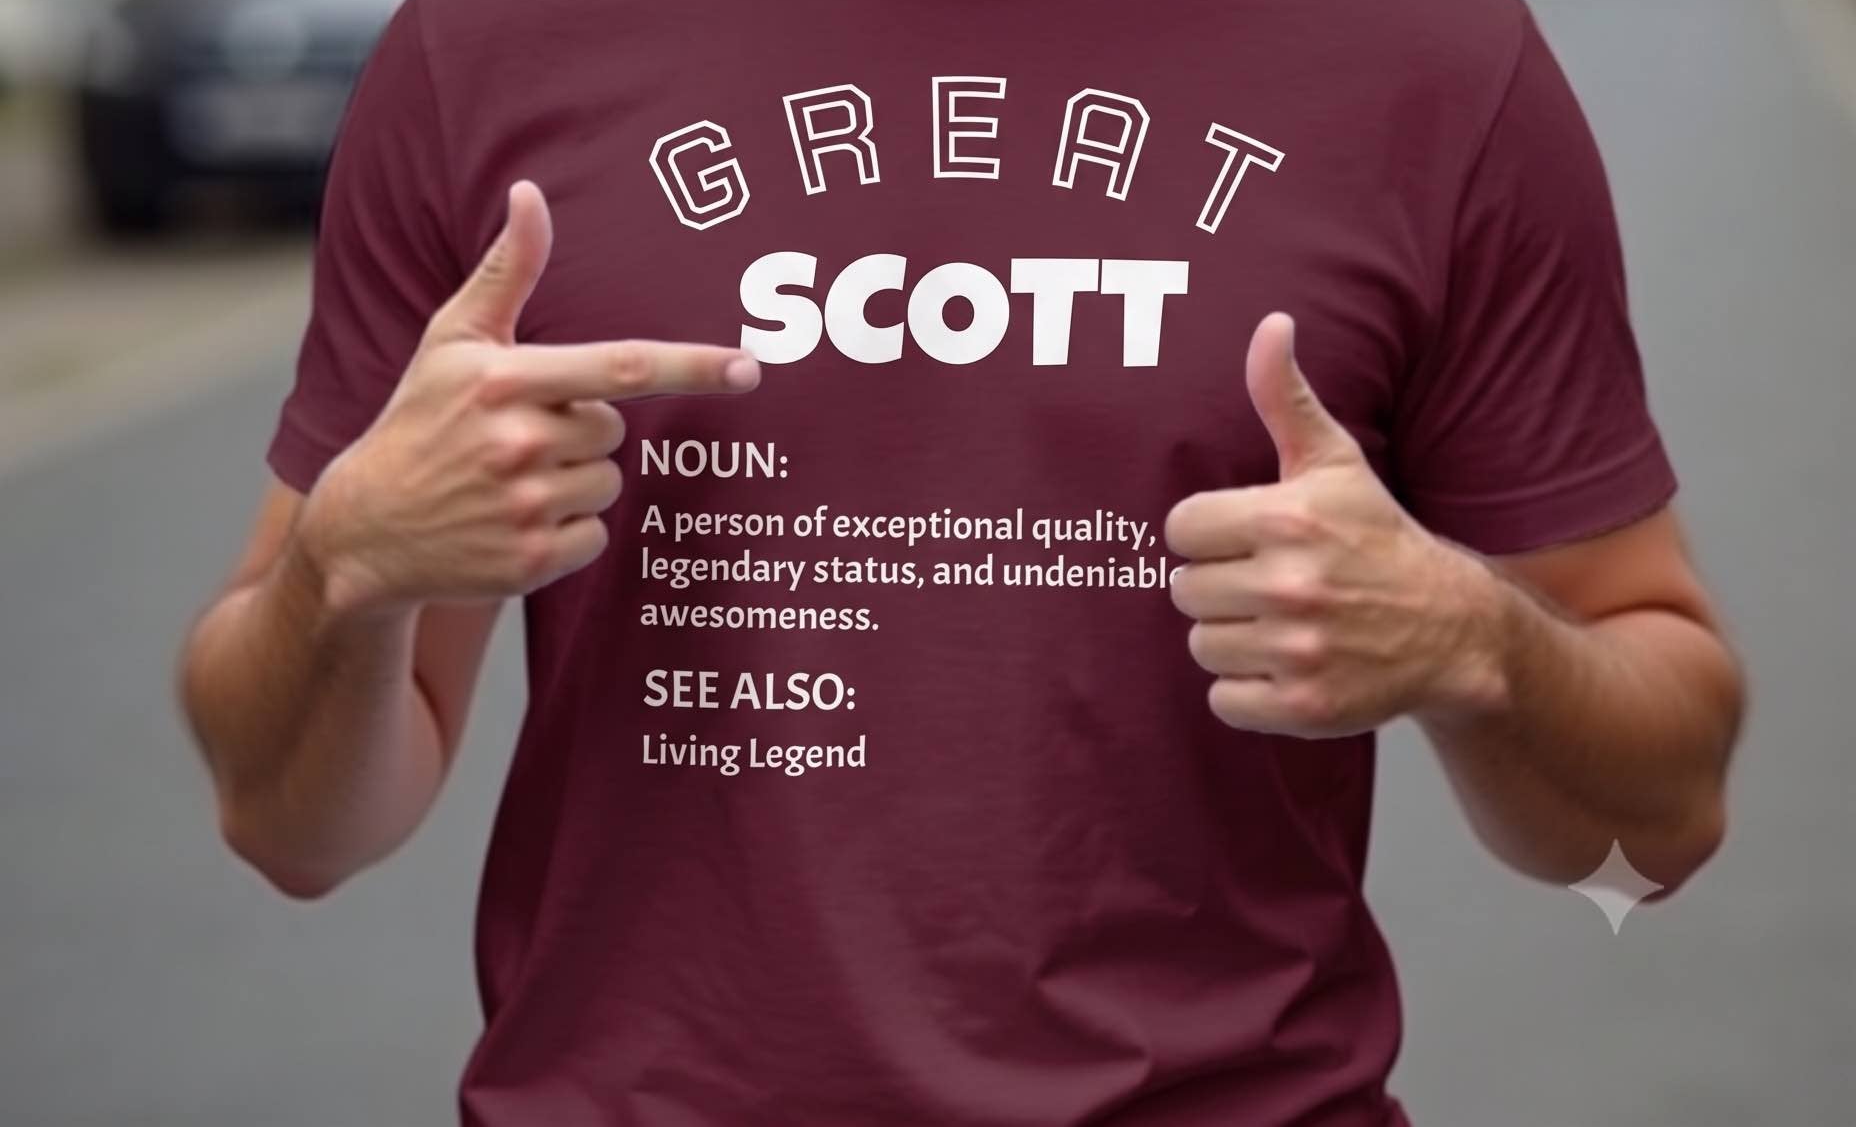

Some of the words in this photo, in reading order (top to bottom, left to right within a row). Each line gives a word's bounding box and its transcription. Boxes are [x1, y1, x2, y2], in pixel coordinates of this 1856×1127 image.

[648, 75, 1286, 235] GREAT
[739, 251, 1190, 367] SCOTT
[641, 439, 789, 478] NOUN:
[641, 504, 666, 533] A
[675, 513, 784, 542] person
[793, 505, 828, 537] of
[832, 508, 1023, 547] exceptional
[1032, 509, 1156, 551] quality,
[641, 547, 806, 592] legendary
[813, 556, 925, 590] status,
[932, 554, 994, 586] and
[640, 604, 879, 632] awesomeness.
[643, 669, 719, 710] SEE
[730, 672, 856, 711] ALSO:
[642, 733, 741, 777] Living
[750, 734, 866, 779] Legend
